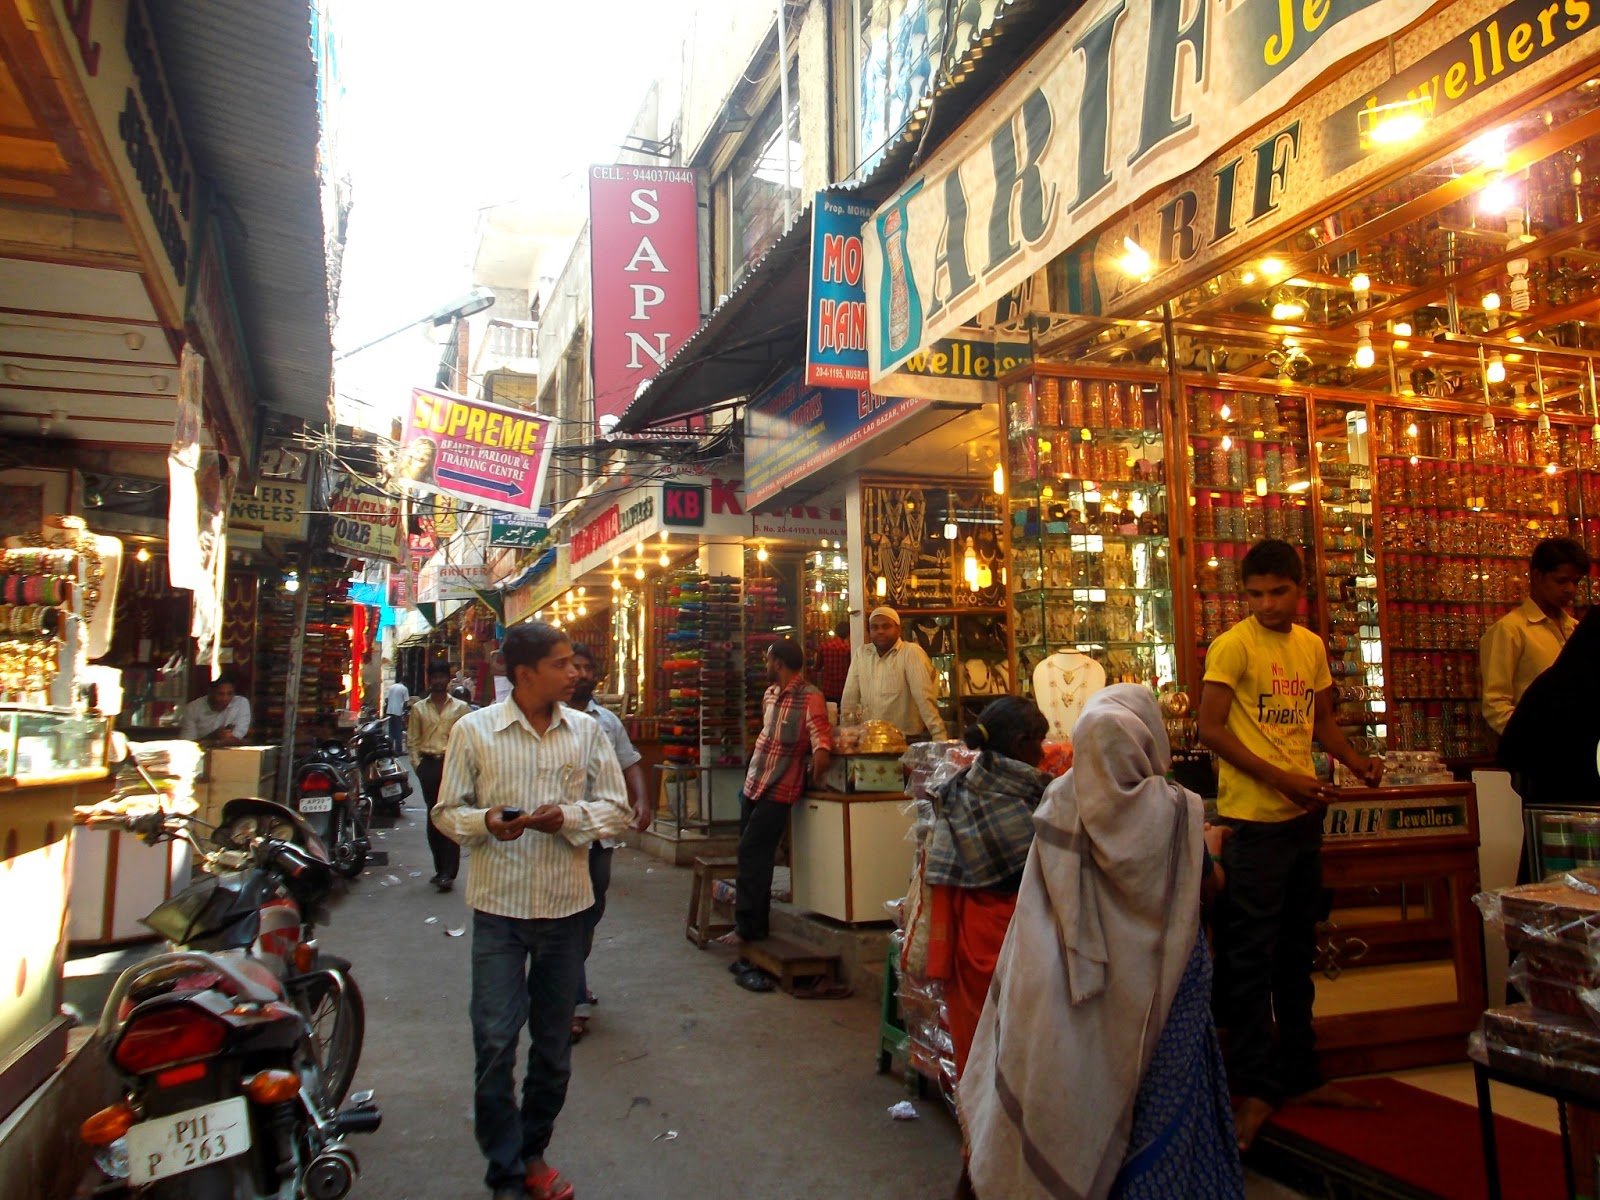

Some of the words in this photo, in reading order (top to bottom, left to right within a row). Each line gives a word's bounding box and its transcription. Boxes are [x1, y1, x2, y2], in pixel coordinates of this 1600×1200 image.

[1359, 0, 1591, 150] Jwellers
[926, 0, 1204, 319] ARIF
[593, 167, 623, 180] CELL
[632, 168, 693, 184] 9440370440
[824, 201, 845, 216] Prop.
[847, 205, 875, 218] MOHA
[624, 188, 671, 372] SAPN
[819, 298, 868, 354] HAN
[845, 369, 868, 381] NUSRAT
[412, 395, 540, 456] SUPREME
[440, 439, 476, 457] BEAUTY
[478, 446, 520, 466] PARLOUR
[523, 458, 530, 470] &
[441, 451, 486, 472] TRAINING
[489, 464, 525, 482] CENTRE
[666, 489, 699, 519] KB
[764, 525, 775, 533] No.
[819, 528, 839, 536] BILAL
[1397, 809, 1453, 828] Jewellers
